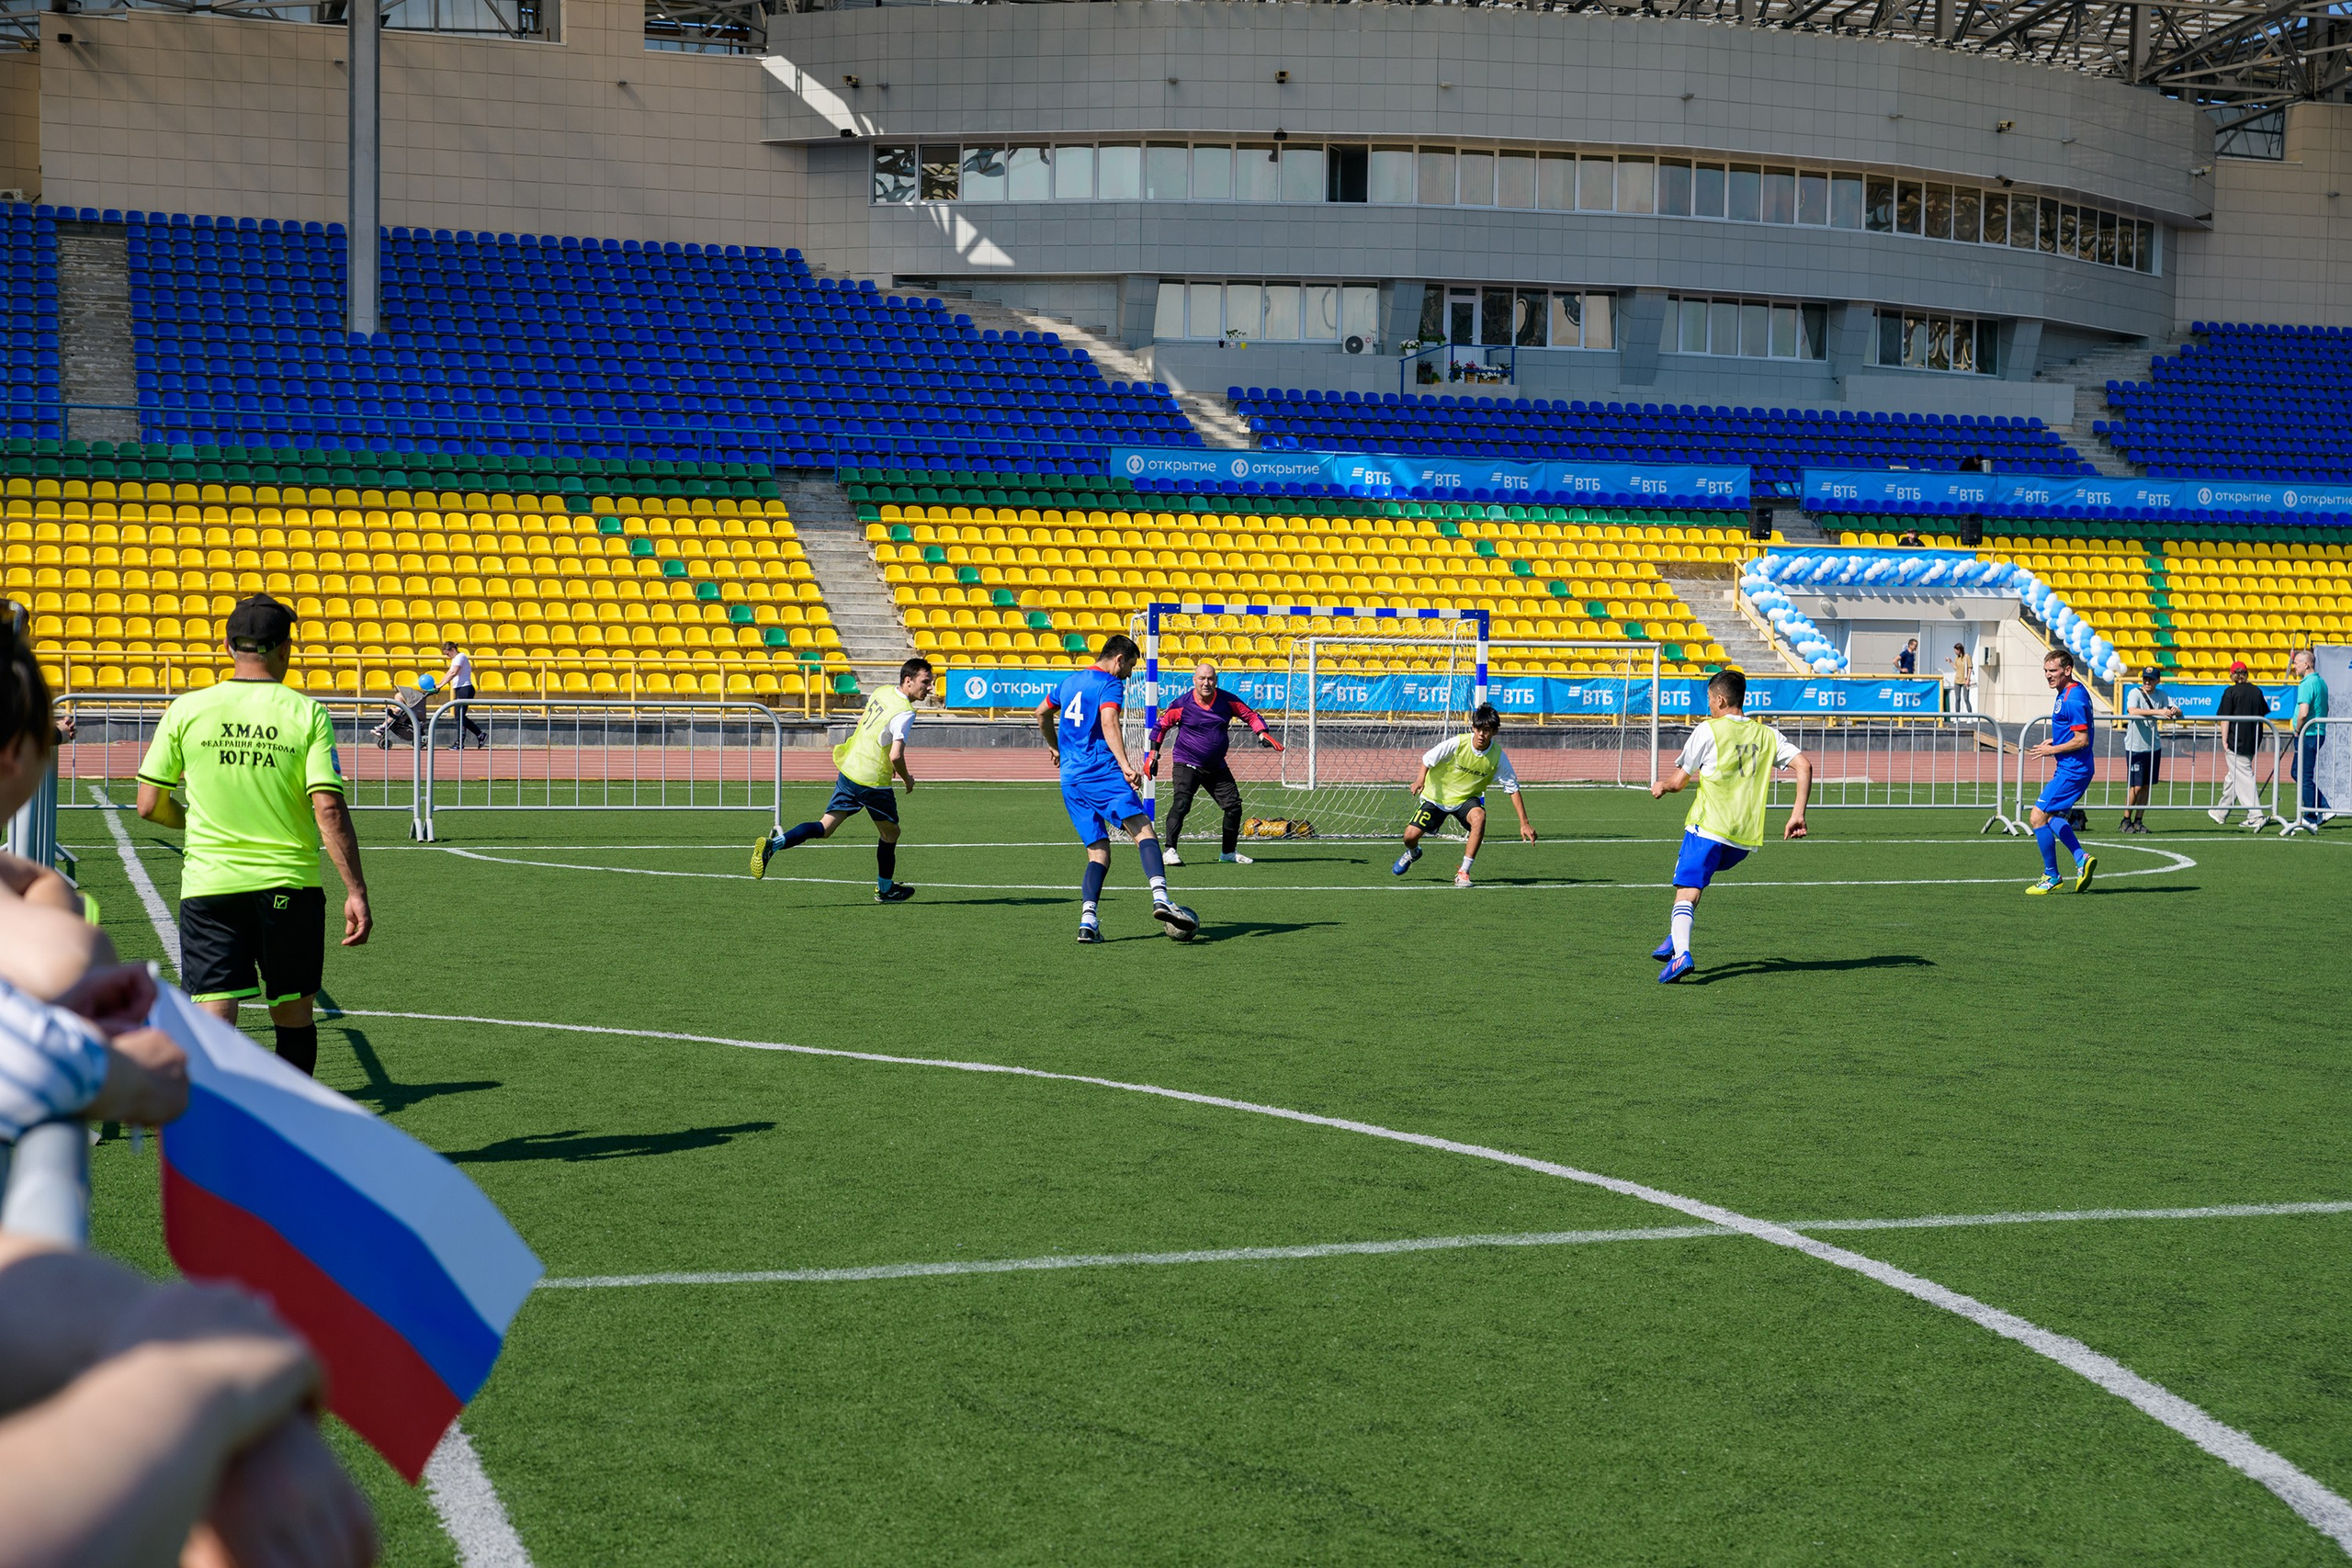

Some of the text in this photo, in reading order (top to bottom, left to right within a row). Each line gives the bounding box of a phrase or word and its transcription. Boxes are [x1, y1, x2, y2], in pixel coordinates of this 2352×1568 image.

[1148, 459, 1216, 473] открытие
[1251, 463, 1320, 477] открытие
[1364, 471, 1392, 486] ВТБ
[1434, 473, 1461, 488] ВТБ
[1503, 476, 1529, 490] ВТБ
[1575, 478, 1600, 491] ВТБ
[1642, 479, 1668, 493] ВТБ
[1708, 481, 1733, 494] ВТБ
[1833, 485, 1858, 499] ВТБ
[1896, 487, 1921, 500] ВТБ
[1960, 489, 1984, 502] ВТБ
[2025, 491, 2049, 503] ВТБ
[2086, 491, 2111, 504] ВТБ
[2148, 493, 2171, 506] ВТБ
[2215, 491, 2271, 504] открытие
[991, 682, 1057, 697] открыт
[1254, 683, 1284, 700] ВТБ
[1336, 686, 1369, 702] ВТБ
[1418, 686, 1450, 703] ВТБ
[1503, 688, 1535, 704] ВТБ
[1582, 689, 1613, 705] ВТБ
[1660, 691, 1691, 706] ВТБ
[1743, 691, 1771, 706] ВТБ
[1818, 691, 1846, 706] ВТБ
[1893, 692, 1921, 707] ВТБ
[1064, 691, 1084, 727] 4
[220, 723, 278, 740] ХМАО
[200, 740, 296, 754] ФЕДЕРАЦИЯ ФУТБОЛА
[220, 750, 277, 768] ЮГРА
[1413, 809, 1431, 827] 12
